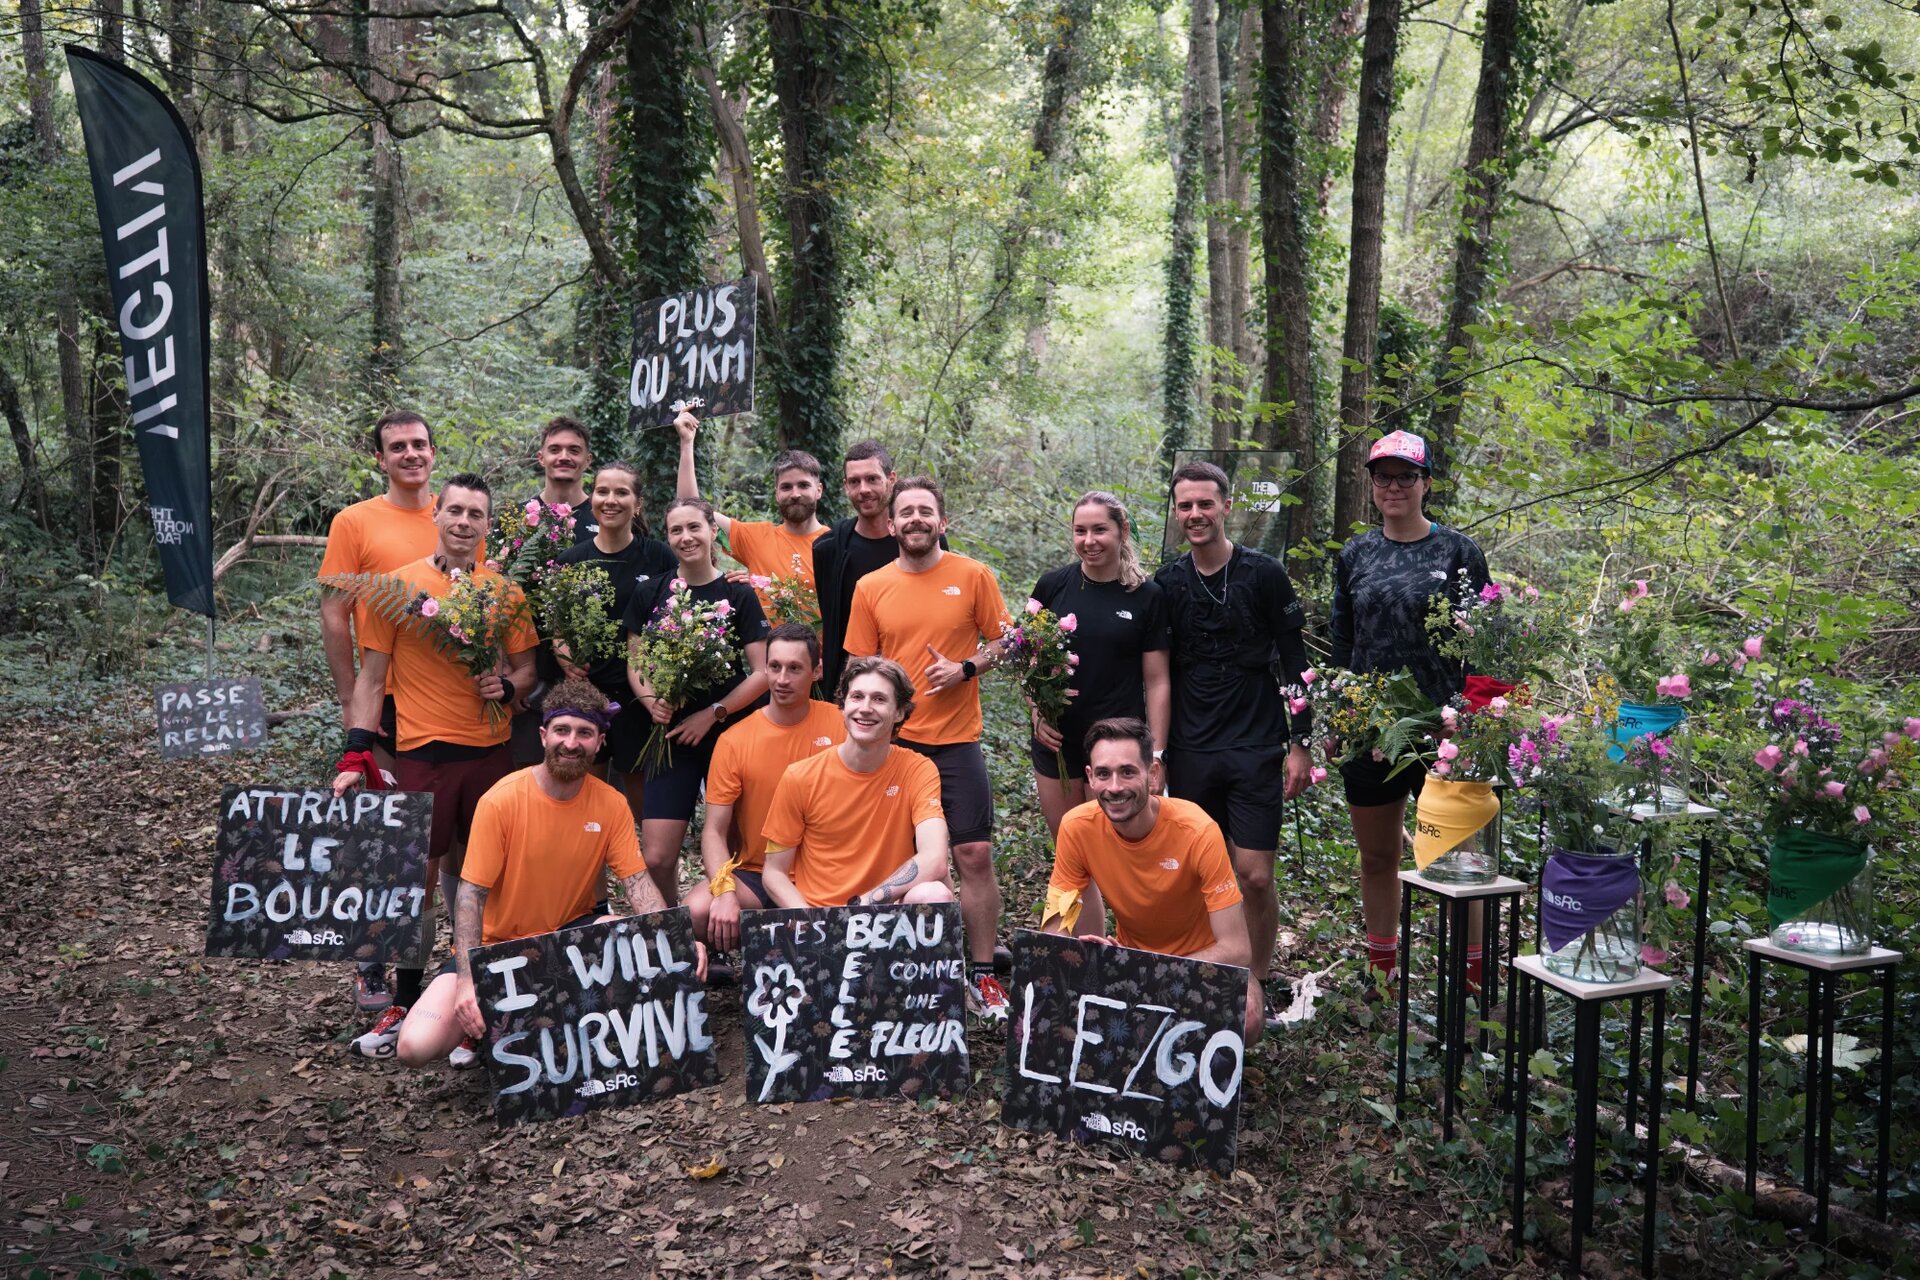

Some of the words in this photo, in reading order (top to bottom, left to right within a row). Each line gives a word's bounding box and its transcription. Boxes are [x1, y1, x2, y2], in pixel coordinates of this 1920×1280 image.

[658, 285, 740, 344] PLUS
[162, 685, 246, 712] PASSE
[206, 709, 230, 723] LE
[227, 790, 407, 827] ATTRAPE
[283, 833, 341, 873] LE
[223, 878, 426, 923] BOUQUET
[846, 912, 943, 950] BEAU
[486, 955, 539, 1011] I
[889, 959, 964, 981] COMME
[870, 1019, 968, 1058] FLEUR
[1019, 982, 1244, 1108] LEZGO
